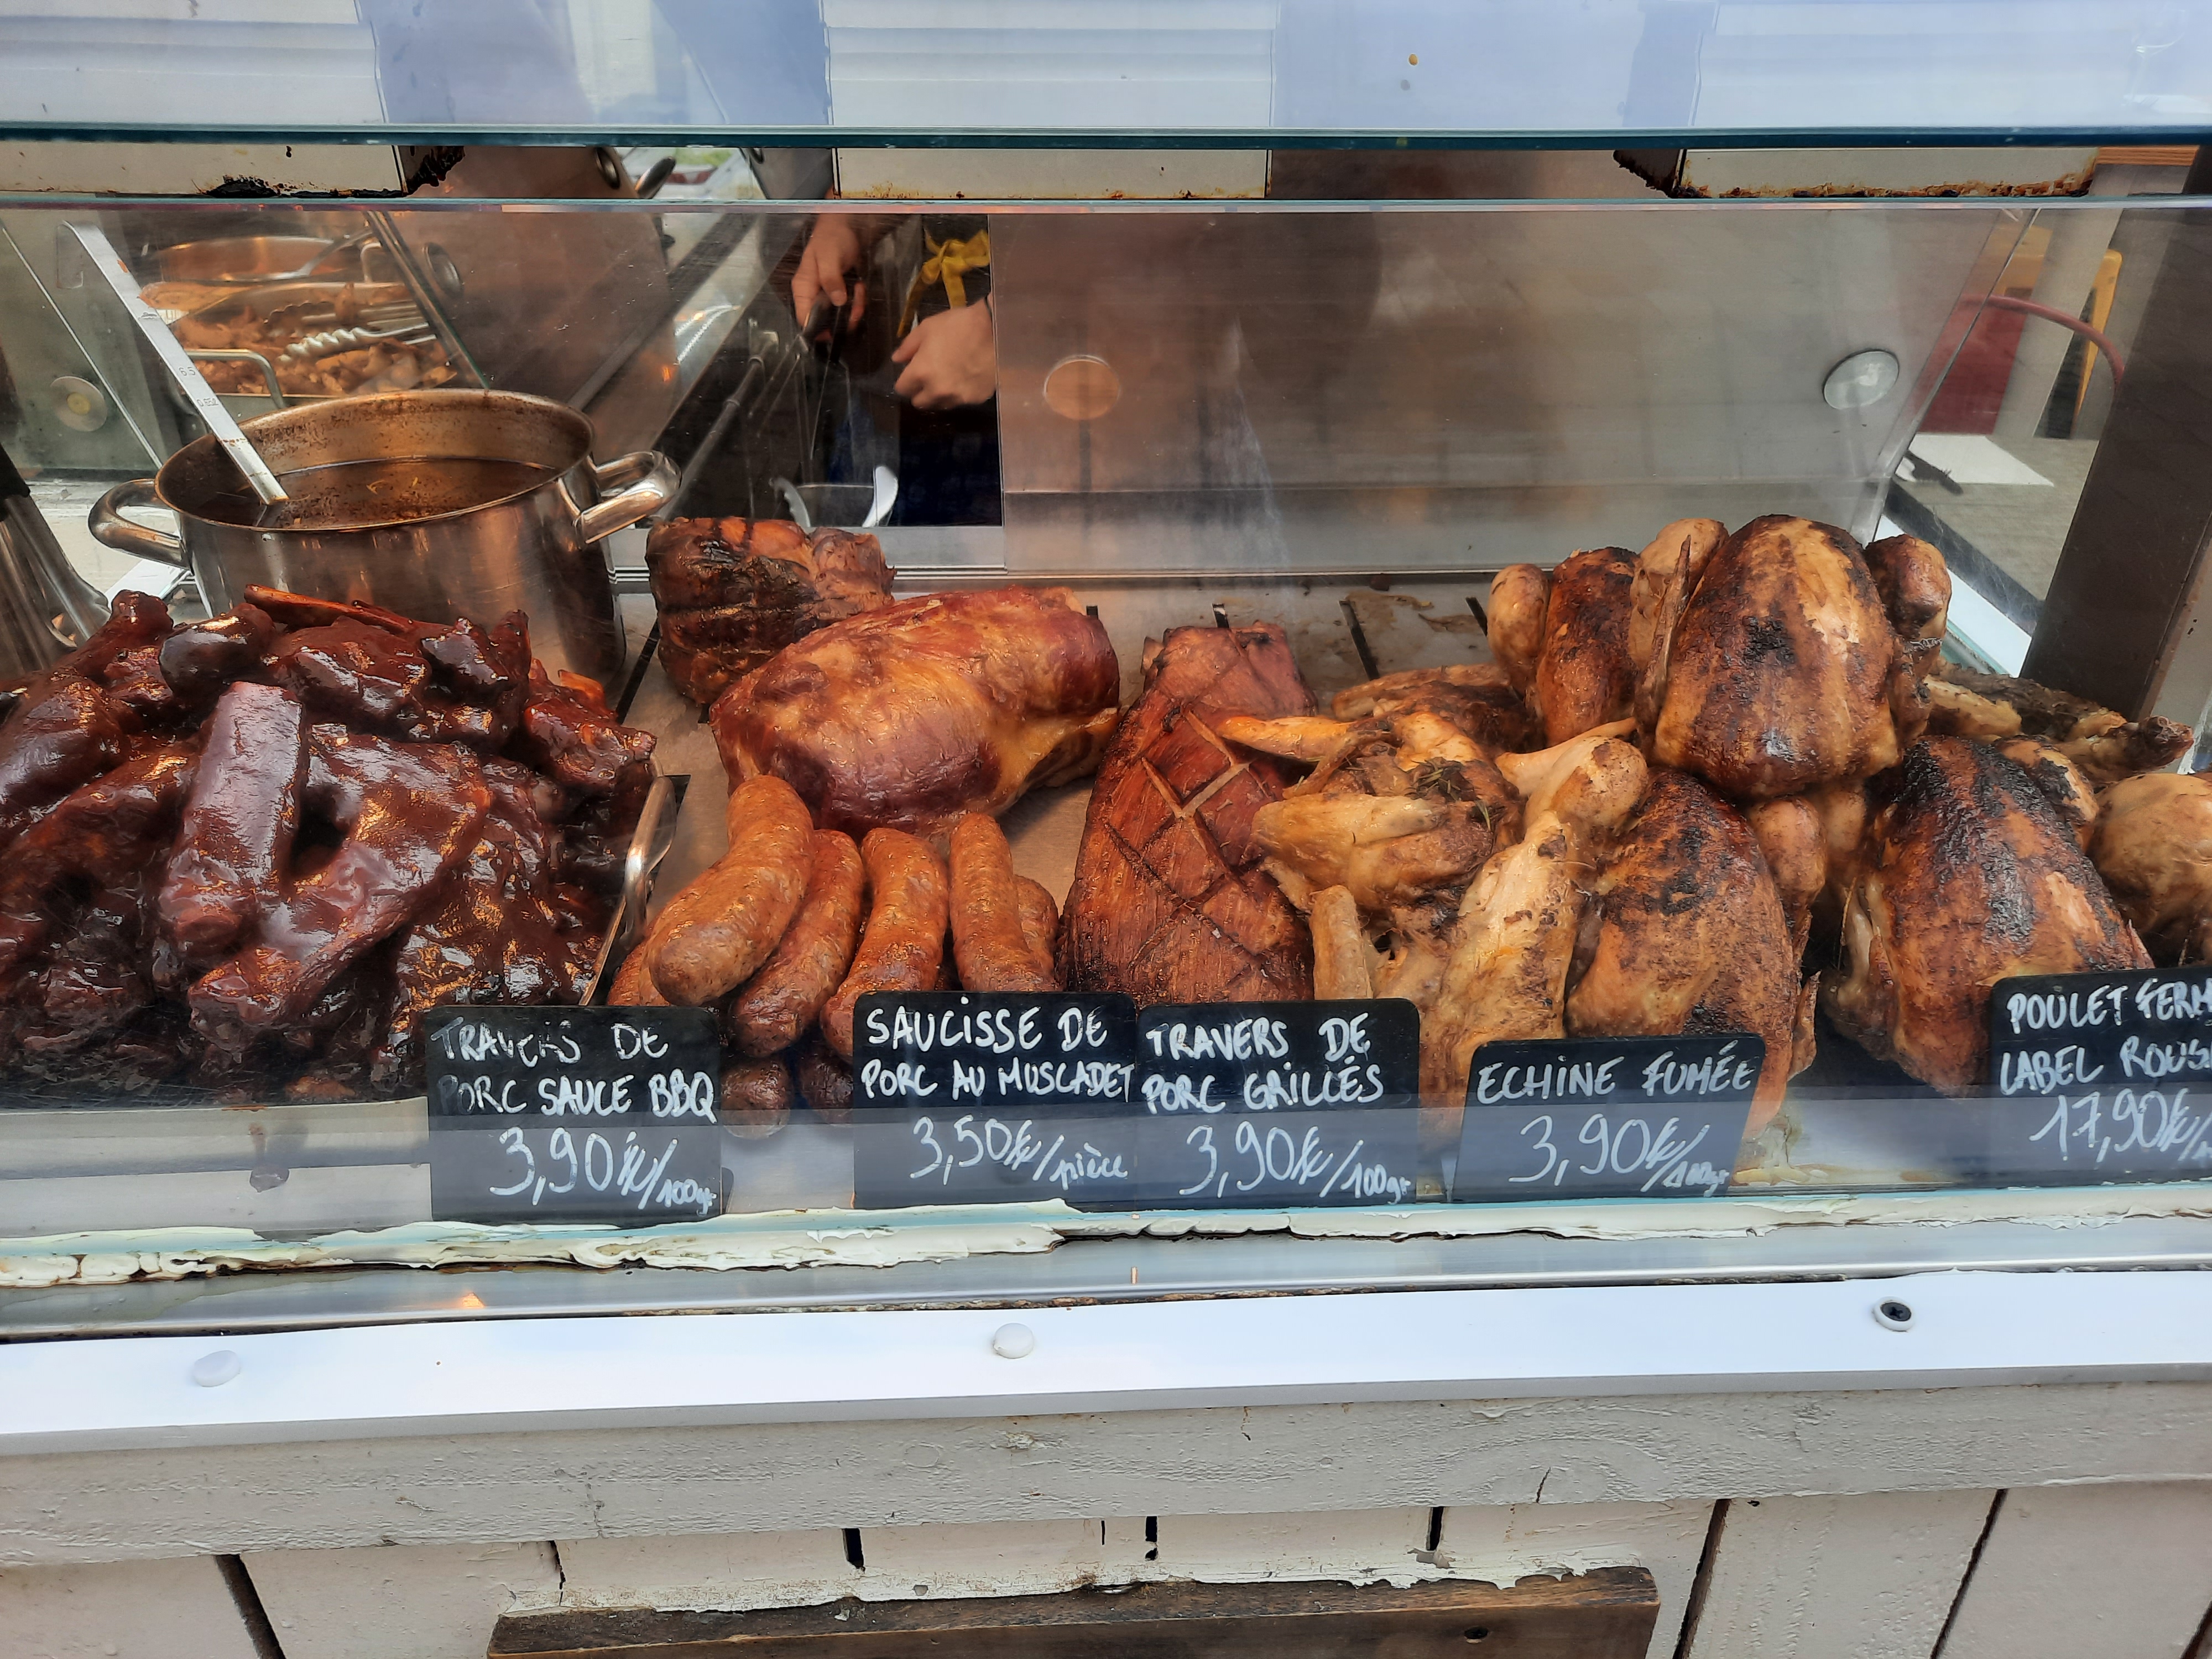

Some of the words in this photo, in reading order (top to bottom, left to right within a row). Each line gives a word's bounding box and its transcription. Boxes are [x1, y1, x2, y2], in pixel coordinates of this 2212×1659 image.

[866, 997, 1042, 1053] SAUCISSE
[1057, 1006, 1108, 1051] DE
[2006, 985, 2128, 1035] POULET
[611, 1022, 669, 1060] DE
[1145, 1016, 1288, 1061] TRAVERS
[1318, 1012, 1371, 1062] DE
[860, 1058, 939, 1099] PORC
[952, 1059, 987, 1101] AU
[998, 1056, 1136, 1103] MUSCADET
[1141, 1073, 1227, 1114] PORC
[1475, 1055, 1625, 1104] ECHINE
[1641, 1040, 1757, 1097] FUMÉE
[1999, 1045, 2105, 1095] LABEL
[537, 1074, 635, 1117] SAUCE
[648, 1068, 718, 1124] BBQ
